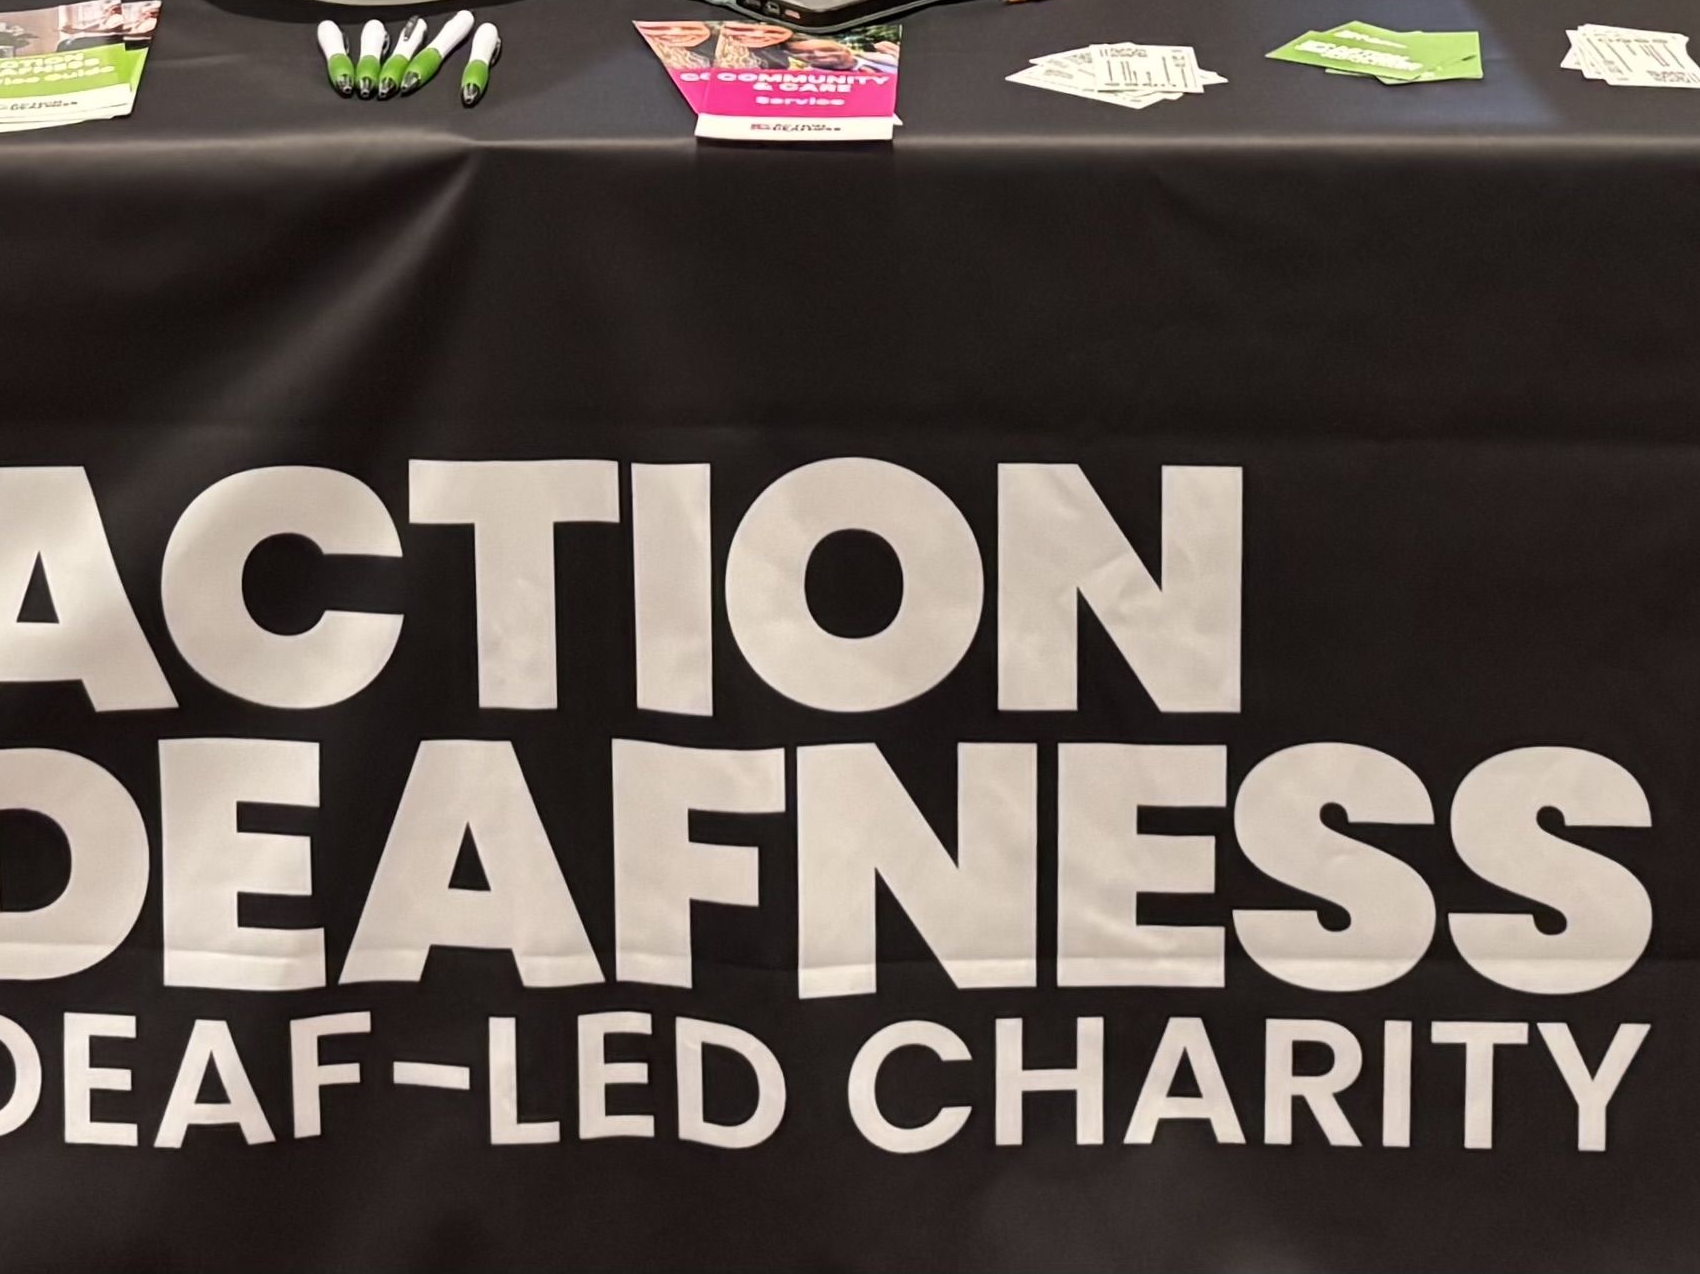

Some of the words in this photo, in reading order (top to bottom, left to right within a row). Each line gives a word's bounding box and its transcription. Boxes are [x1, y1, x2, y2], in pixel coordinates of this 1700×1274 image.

[717, 72, 889, 85] COMMUNITY
[753, 83, 772, 92] &
[779, 82, 851, 93] CARE
[756, 96, 845, 106] Service
[847, 1017, 1651, 1156] CHARITY
